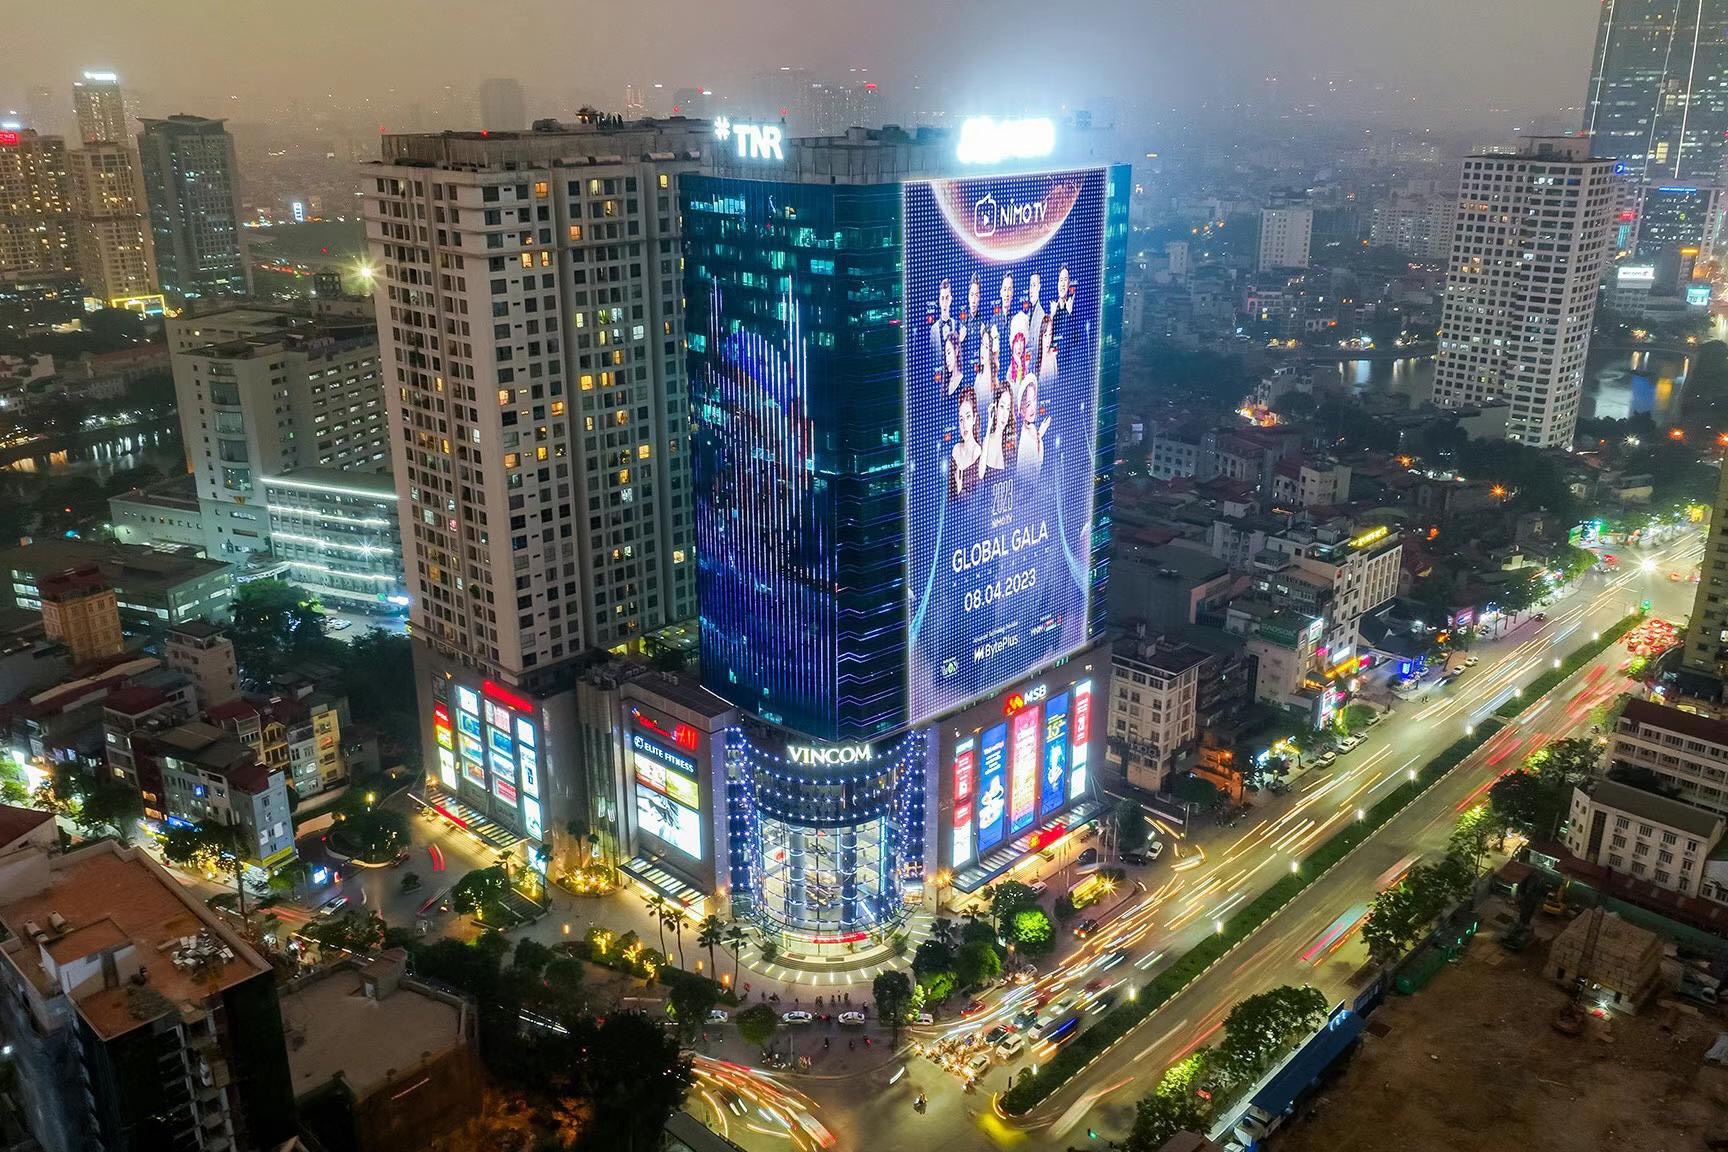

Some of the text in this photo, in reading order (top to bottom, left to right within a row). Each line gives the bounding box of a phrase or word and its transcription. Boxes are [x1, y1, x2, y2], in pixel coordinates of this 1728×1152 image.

[732, 124, 784, 160] TNR
[952, 520, 1048, 573] GLOBAL GALA
[964, 567, 1036, 612] 08.04.2023
[985, 634, 1019, 659] BytePlus
[1023, 684, 1047, 705] MSB
[644, 742, 695, 773] ELITE FITNESS
[787, 743, 872, 764] VINCOM
